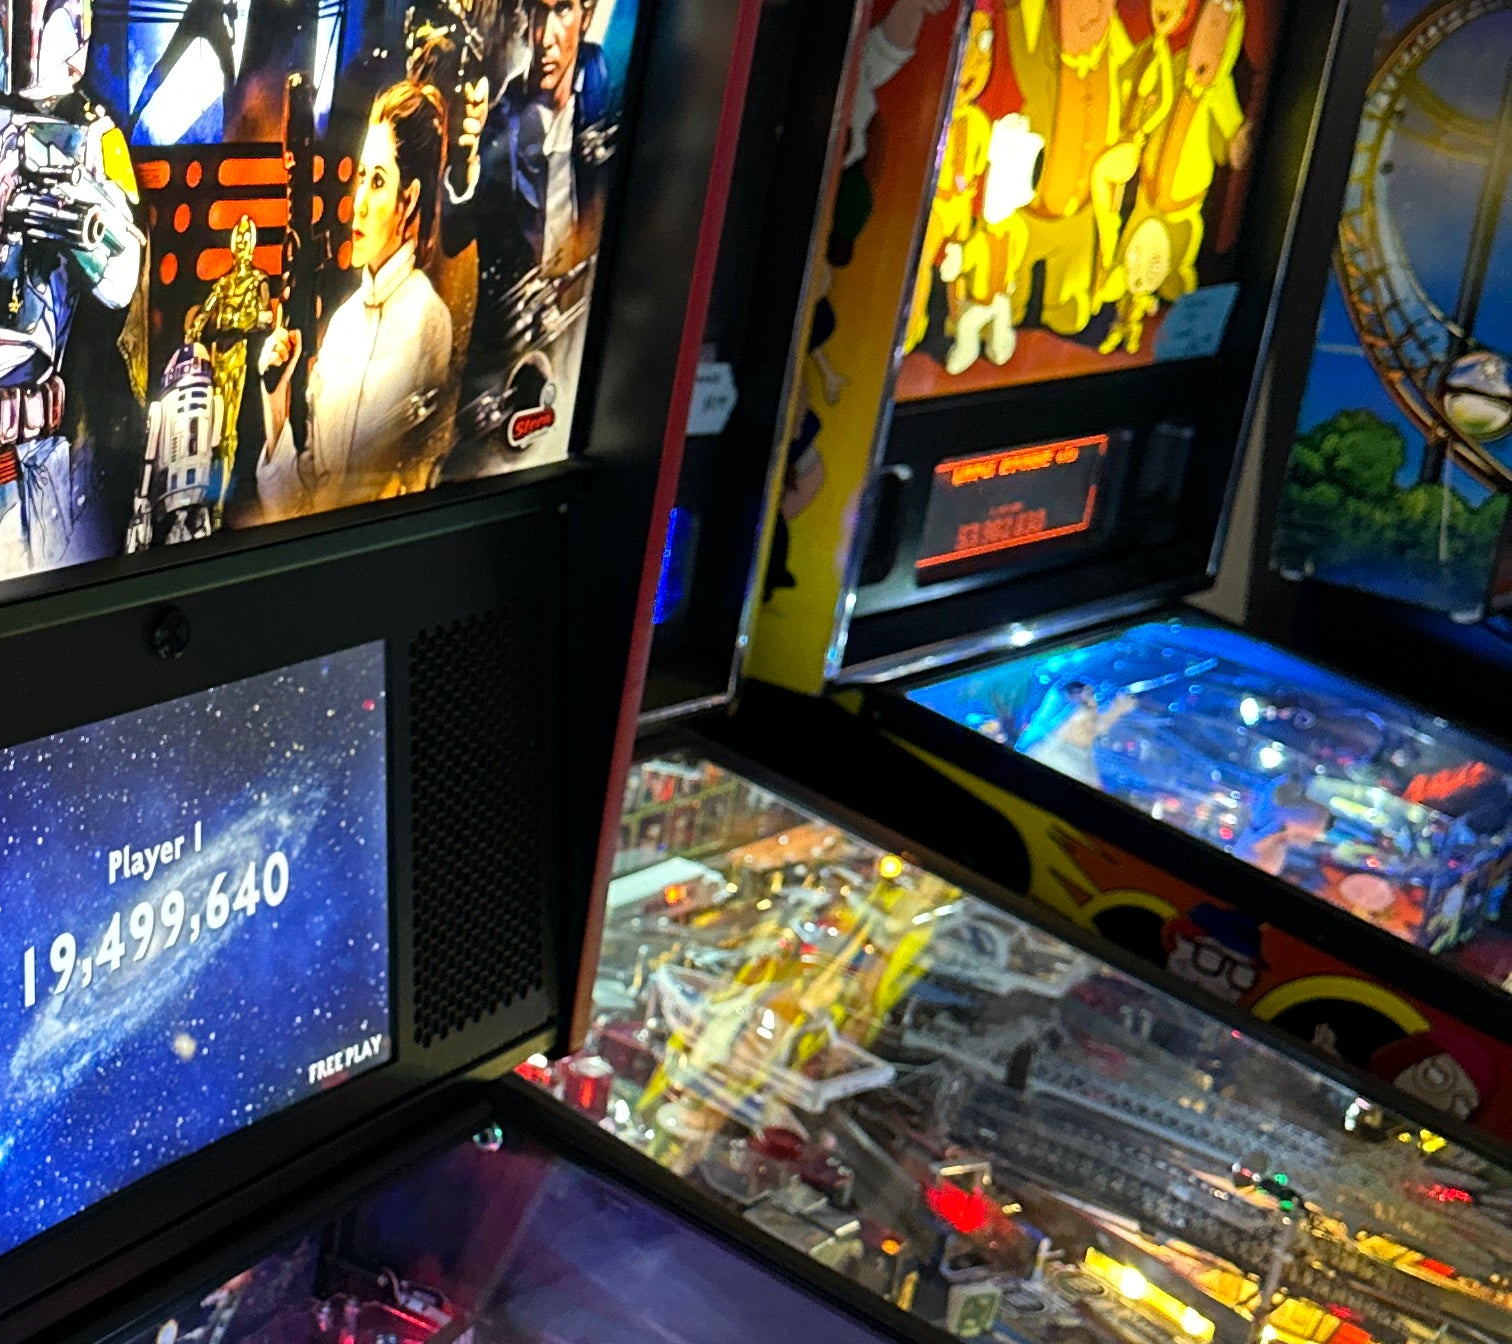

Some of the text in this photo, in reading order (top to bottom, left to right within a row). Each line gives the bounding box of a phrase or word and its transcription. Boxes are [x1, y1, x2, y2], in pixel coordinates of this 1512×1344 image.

[109, 836, 185, 884] Player
[24, 851, 289, 1008] 19,499,640
[309, 1033, 383, 1084] FREE PLAY
